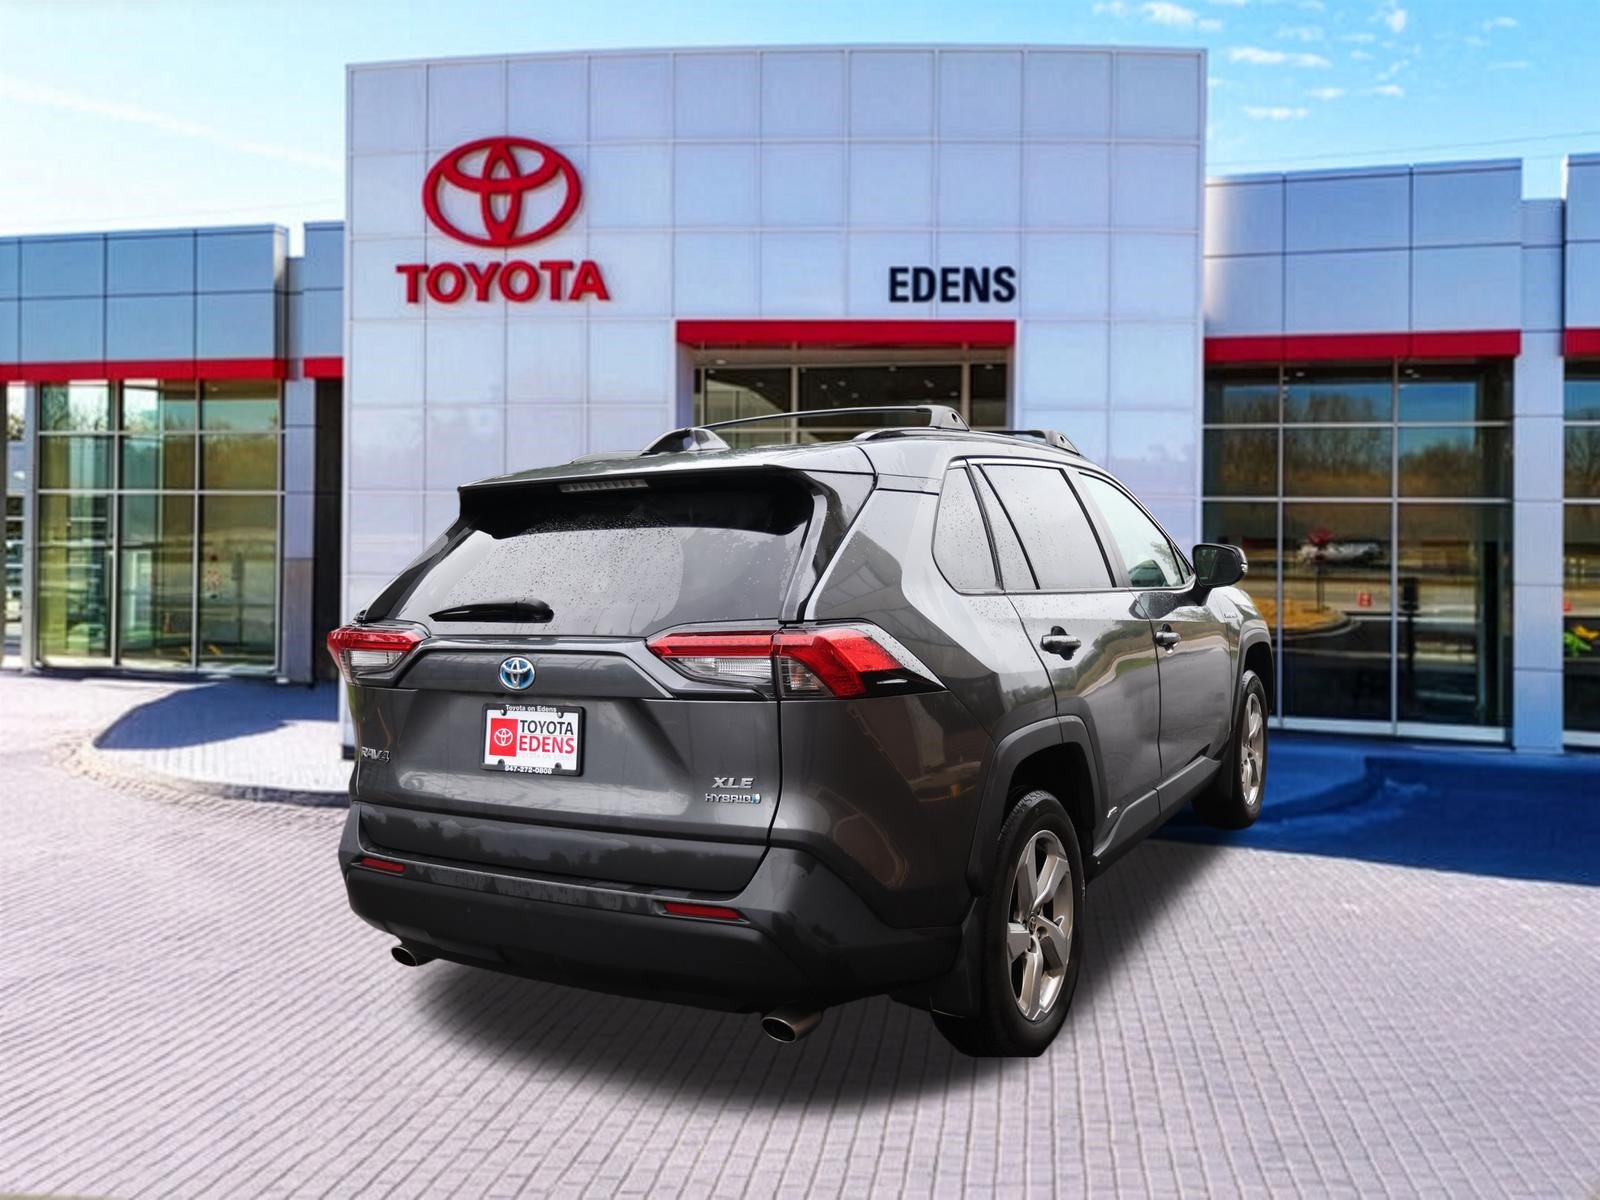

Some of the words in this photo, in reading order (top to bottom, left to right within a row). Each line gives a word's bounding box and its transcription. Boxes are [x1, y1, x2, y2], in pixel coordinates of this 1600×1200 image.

[396, 260, 610, 303] TOYOTA
[889, 266, 1016, 303] EDENS
[506, 704, 526, 712] Toyota
[537, 705, 557, 713] Edens
[520, 720, 574, 735] TOYOTA
[519, 735, 575, 754] EDENS
[361, 746, 390, 763] RAV4
[712, 777, 753, 788] XLE
[705, 793, 751, 803] HYBRID
